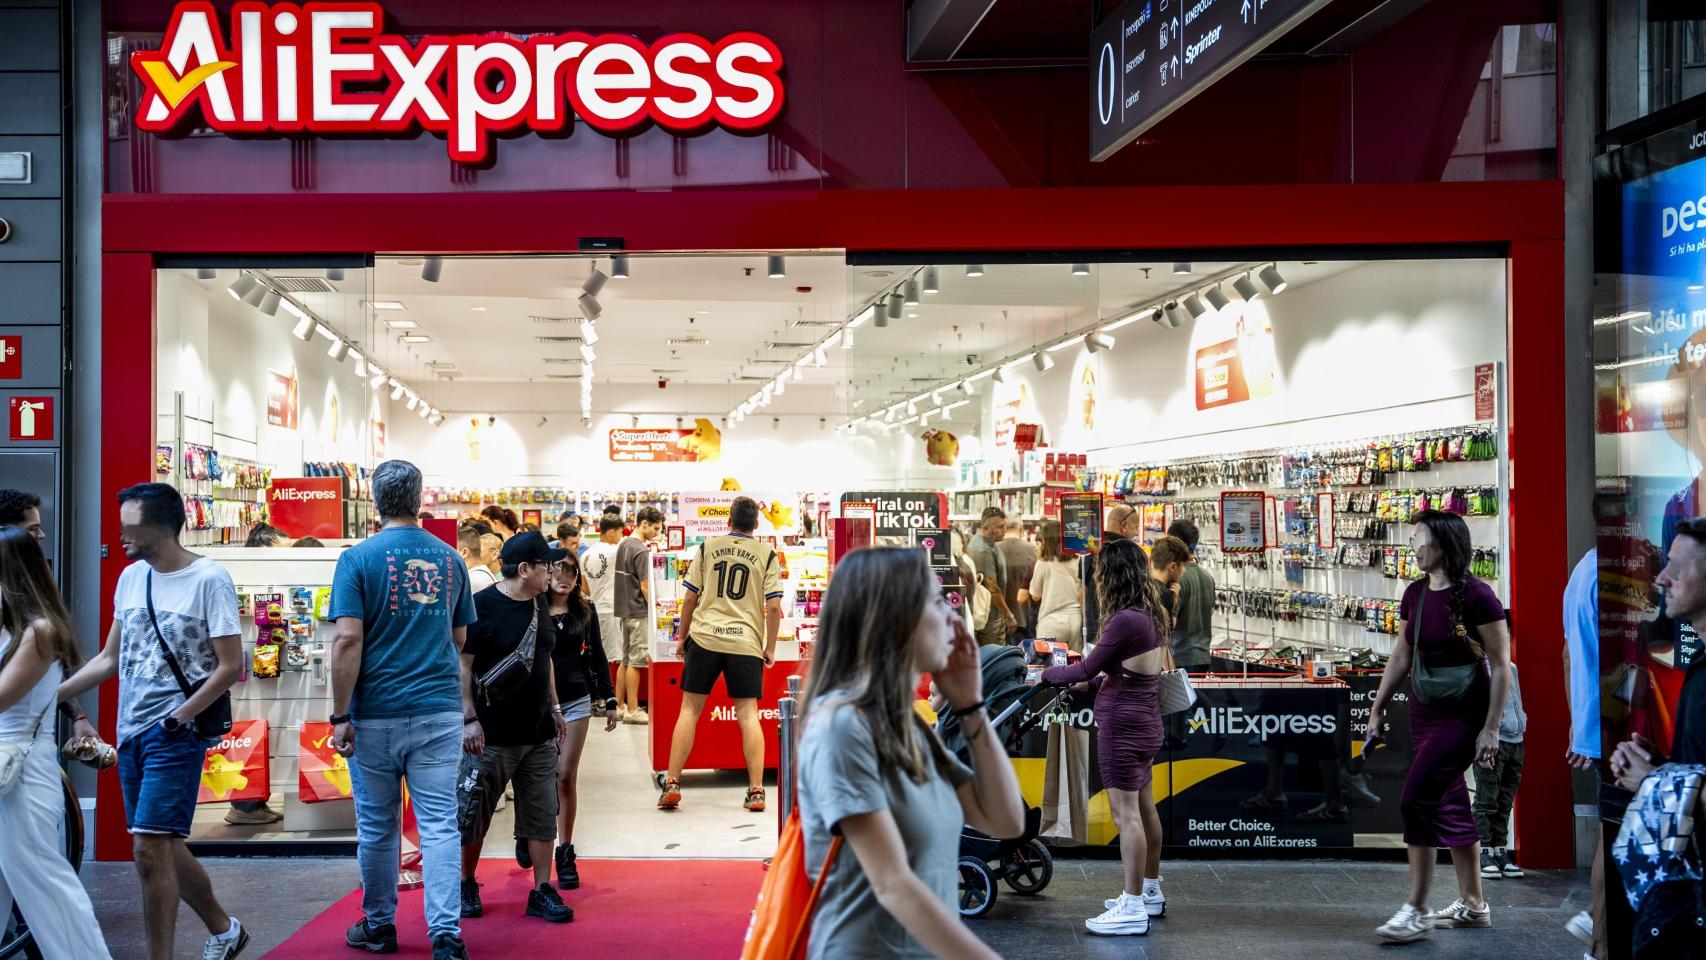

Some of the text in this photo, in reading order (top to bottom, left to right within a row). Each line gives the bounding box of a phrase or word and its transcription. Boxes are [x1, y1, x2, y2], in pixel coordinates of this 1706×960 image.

[1184, 0, 1216, 26] KINEPOLI
[1185, 24, 1222, 65] Sprinter
[1125, 48, 1146, 74] ascensor
[143, 10, 776, 152] AliExpress
[1125, 90, 1140, 108] caixer
[1669, 245, 1677, 257] Si
[1678, 242, 1685, 255] hi
[1686, 241, 1696, 253] ha
[1685, 340, 1706, 363] te
[272, 488, 336, 503] AliExpress
[864, 497, 925, 511] Viral on
[708, 508, 730, 516] Choic
[874, 512, 937, 529] TikTok
[711, 547, 758, 565] LAMINE YAMAL
[386, 556, 399, 610] ESCAPE
[713, 561, 750, 600] 10
[1680, 645, 1697, 656] Sitge
[1188, 707, 1337, 741] AliExpress
[206, 736, 252, 751] oice
[1189, 819, 1275, 832] Better Choice,
[1189, 836, 1317, 847] always on AliExpress
